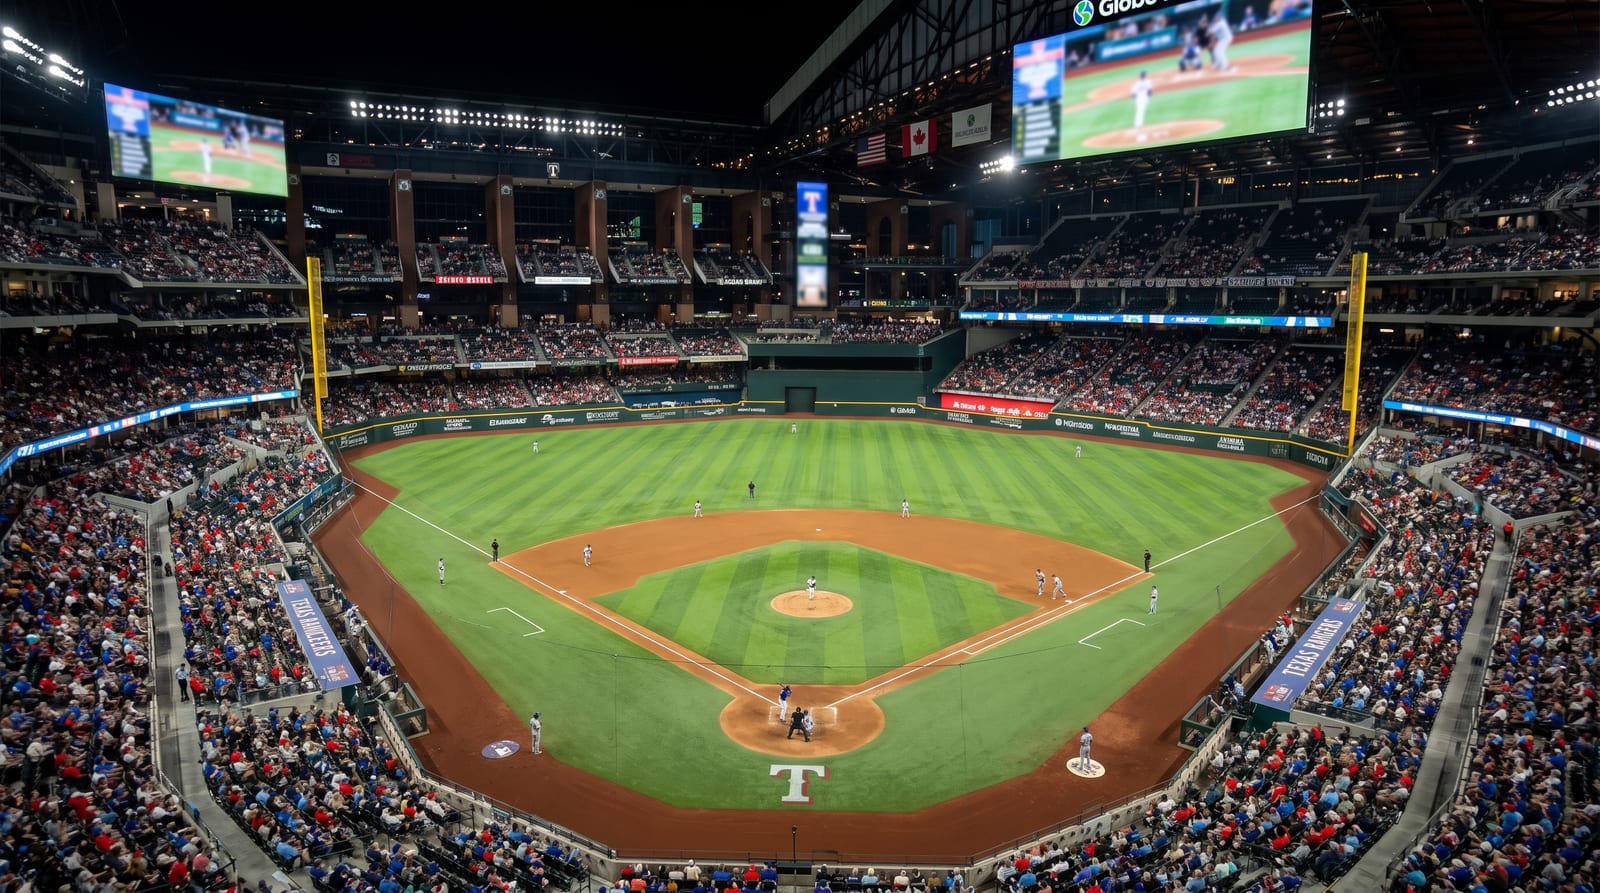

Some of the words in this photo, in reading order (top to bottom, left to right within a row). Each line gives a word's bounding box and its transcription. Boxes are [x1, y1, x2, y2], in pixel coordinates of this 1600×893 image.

[804, 191, 821, 213] T
[290, 597, 316, 618] TEXAS
[1281, 649, 1320, 677] TEXAS
[1303, 618, 1344, 651] RANGERS
[769, 764, 830, 805] T
